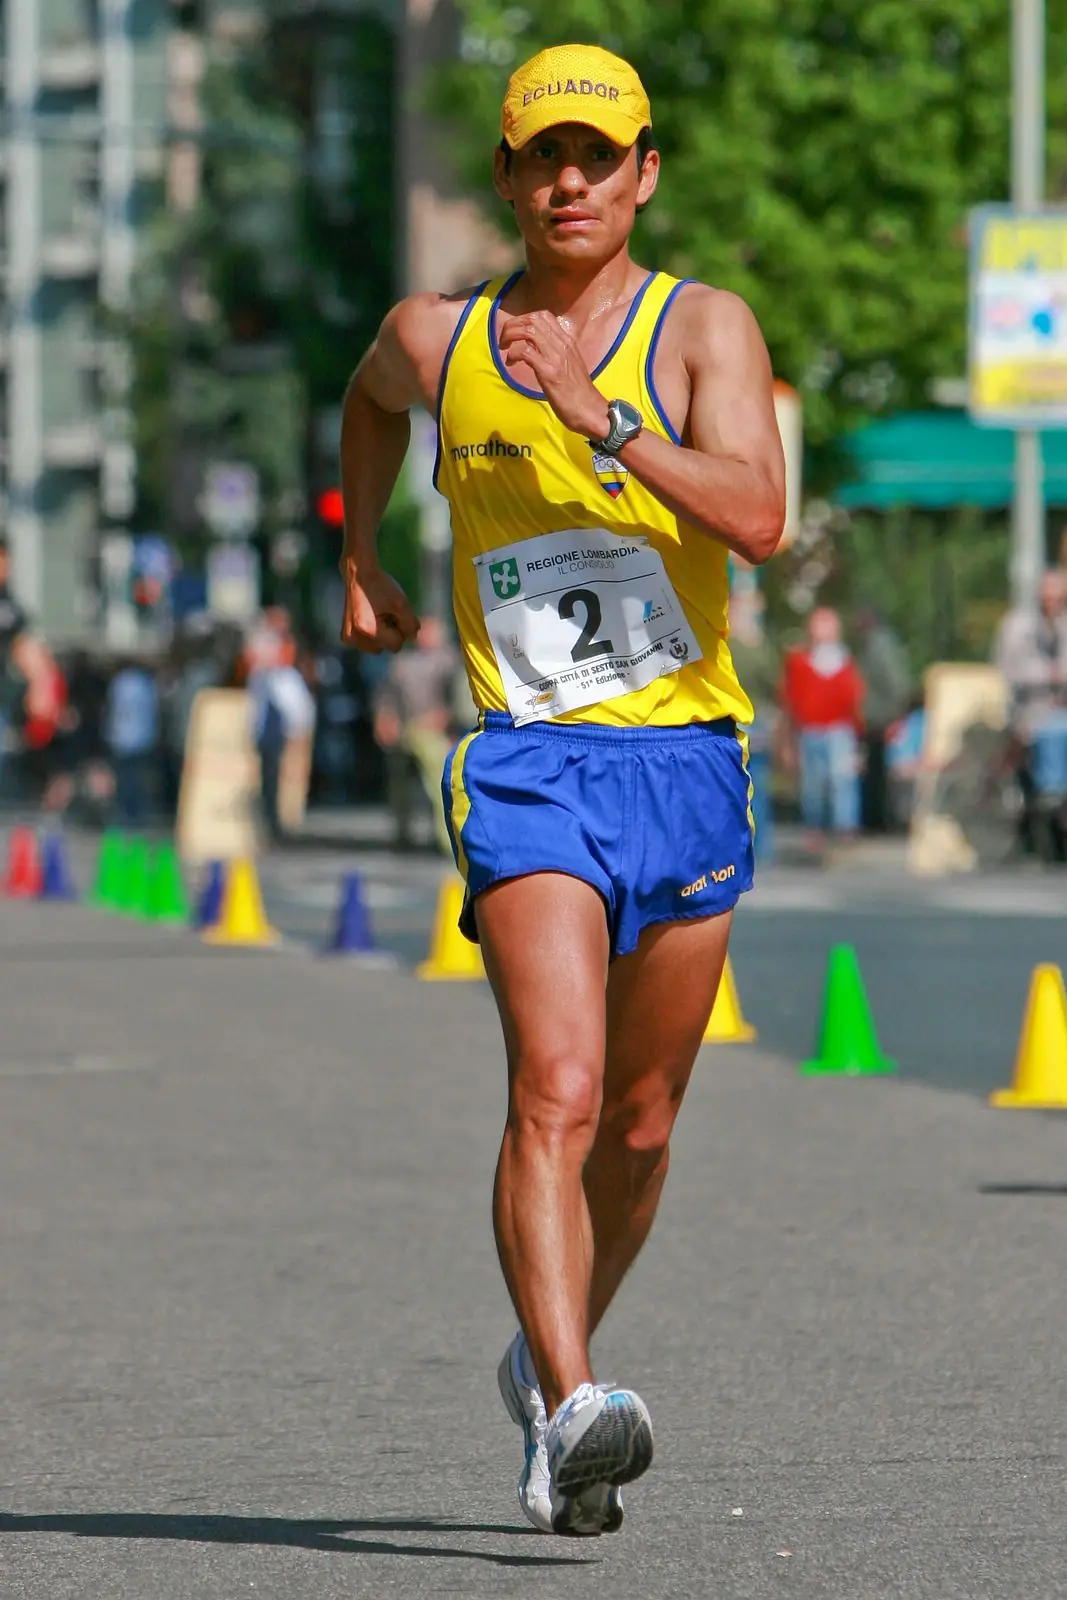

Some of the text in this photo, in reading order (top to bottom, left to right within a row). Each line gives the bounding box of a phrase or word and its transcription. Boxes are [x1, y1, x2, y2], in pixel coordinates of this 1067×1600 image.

[522, 79, 620, 107] ECUADOR
[451, 439, 532, 461] marathon
[526, 546, 640, 572] REGIONE LOMBARDIA
[557, 565, 568, 575] IL
[558, 589, 614, 663] 2
[581, 669, 590, 678] DI
[591, 661, 614, 674] SESTO
[615, 659, 629, 669] SAN
[630, 642, 664, 667] GIOVANNI
[594, 671, 626, 685] Edizione
